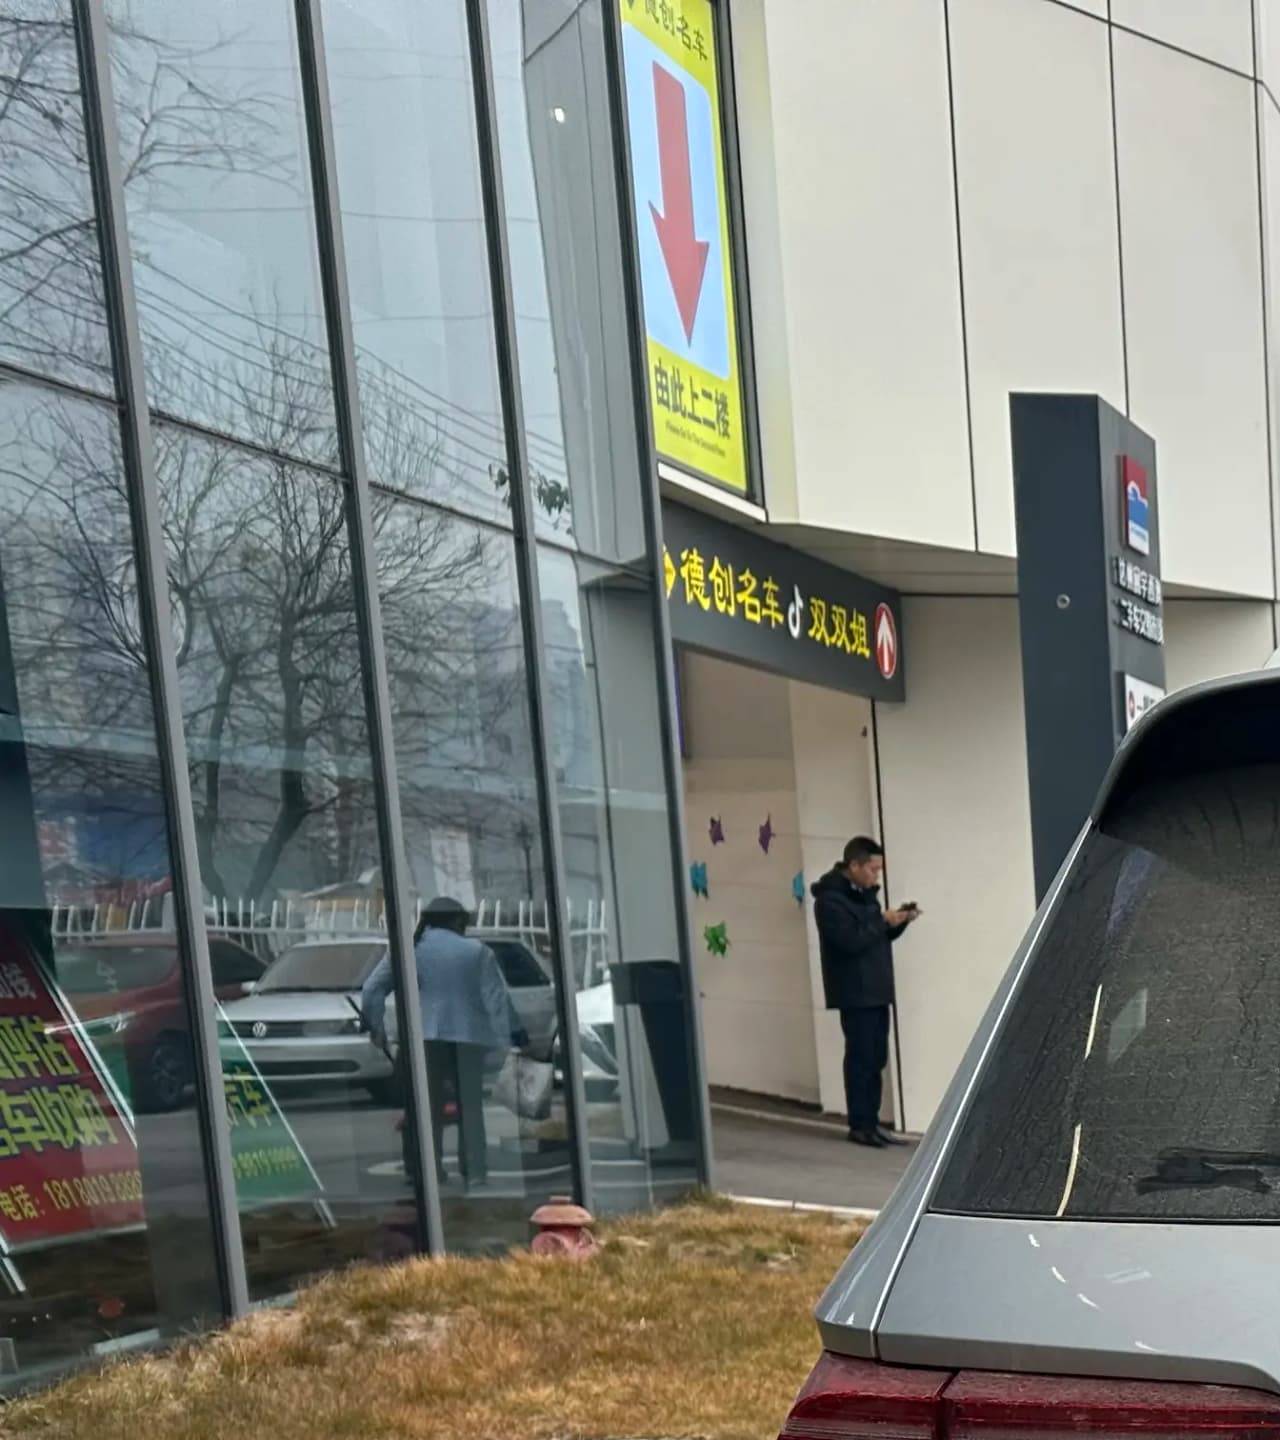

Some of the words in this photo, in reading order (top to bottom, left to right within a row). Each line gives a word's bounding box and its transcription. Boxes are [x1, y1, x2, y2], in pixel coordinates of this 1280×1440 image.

[654, 356, 730, 440] 由此上二楼
[680, 548, 784, 629] 德创名车
[808, 597, 871, 659] 双双姐
[0, 1083, 119, 1156] 车收购
